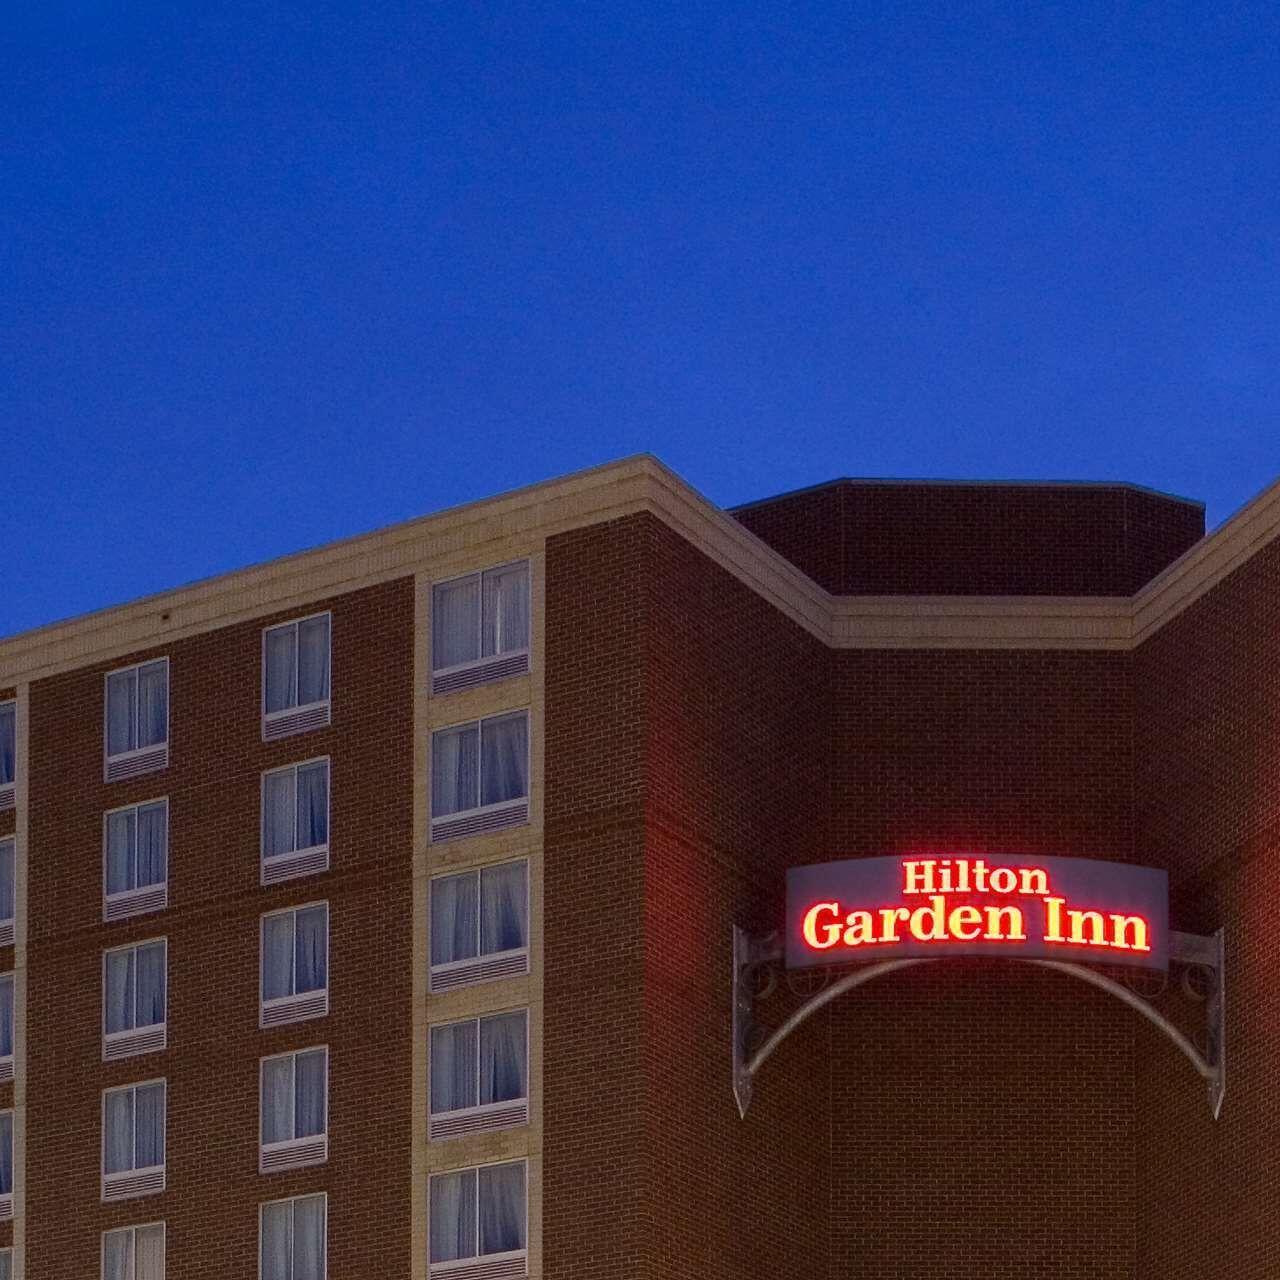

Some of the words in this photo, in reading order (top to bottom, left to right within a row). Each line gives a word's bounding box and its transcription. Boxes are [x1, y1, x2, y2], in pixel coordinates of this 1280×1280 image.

[902, 859, 1050, 895] Hilton
[803, 895, 1027, 949] Garden
[1043, 896, 1151, 951] Inn
